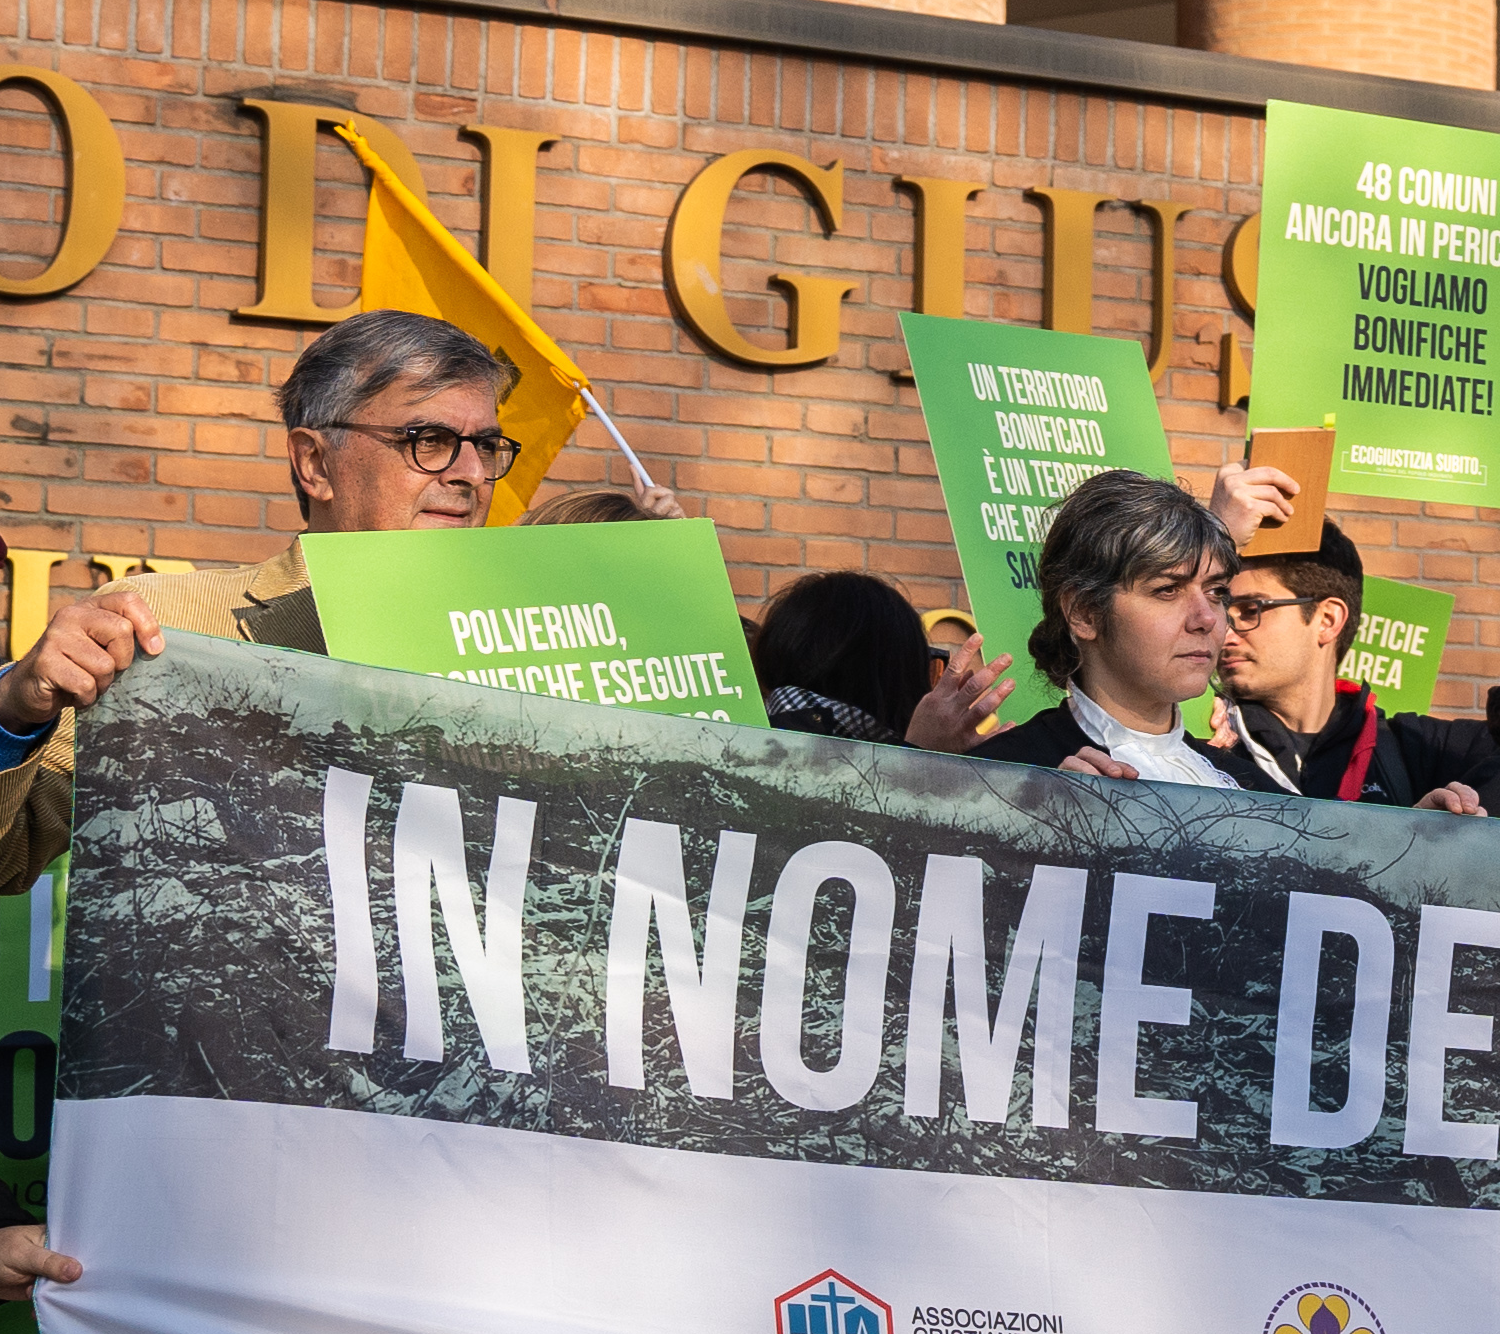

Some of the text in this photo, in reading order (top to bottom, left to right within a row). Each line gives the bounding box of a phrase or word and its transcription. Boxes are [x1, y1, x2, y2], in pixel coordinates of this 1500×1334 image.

[1356, 161, 1497, 216] 48 COMUNI
[1285, 203, 1392, 253] ANCORA
[1400, 217, 1425, 257] IN
[1358, 263, 1487, 314] VOGLIAMO
[1353, 314, 1487, 365] BONIFICHE
[968, 363, 1108, 413] UN TERRITORIO
[1343, 364, 1493, 416] IMMEDIATE!
[995, 411, 1105, 457] BONIFICATO
[1351, 444, 1433, 471] ECOGIUSTIZIA
[1436, 453, 1482, 475] SUBITO.
[983, 448, 1002, 494] È
[999, 457, 1032, 496] UN
[981, 502, 1024, 542] CHE
[448, 603, 627, 655] POLVERINO,
[588, 652, 743, 705] ESEGUITE,
[1338, 648, 1402, 690] AREA
[323, 766, 538, 1076] IN
[604, 818, 1217, 1140] NOME
[912, 1306, 1063, 1334] ASSOCIAZIONI
